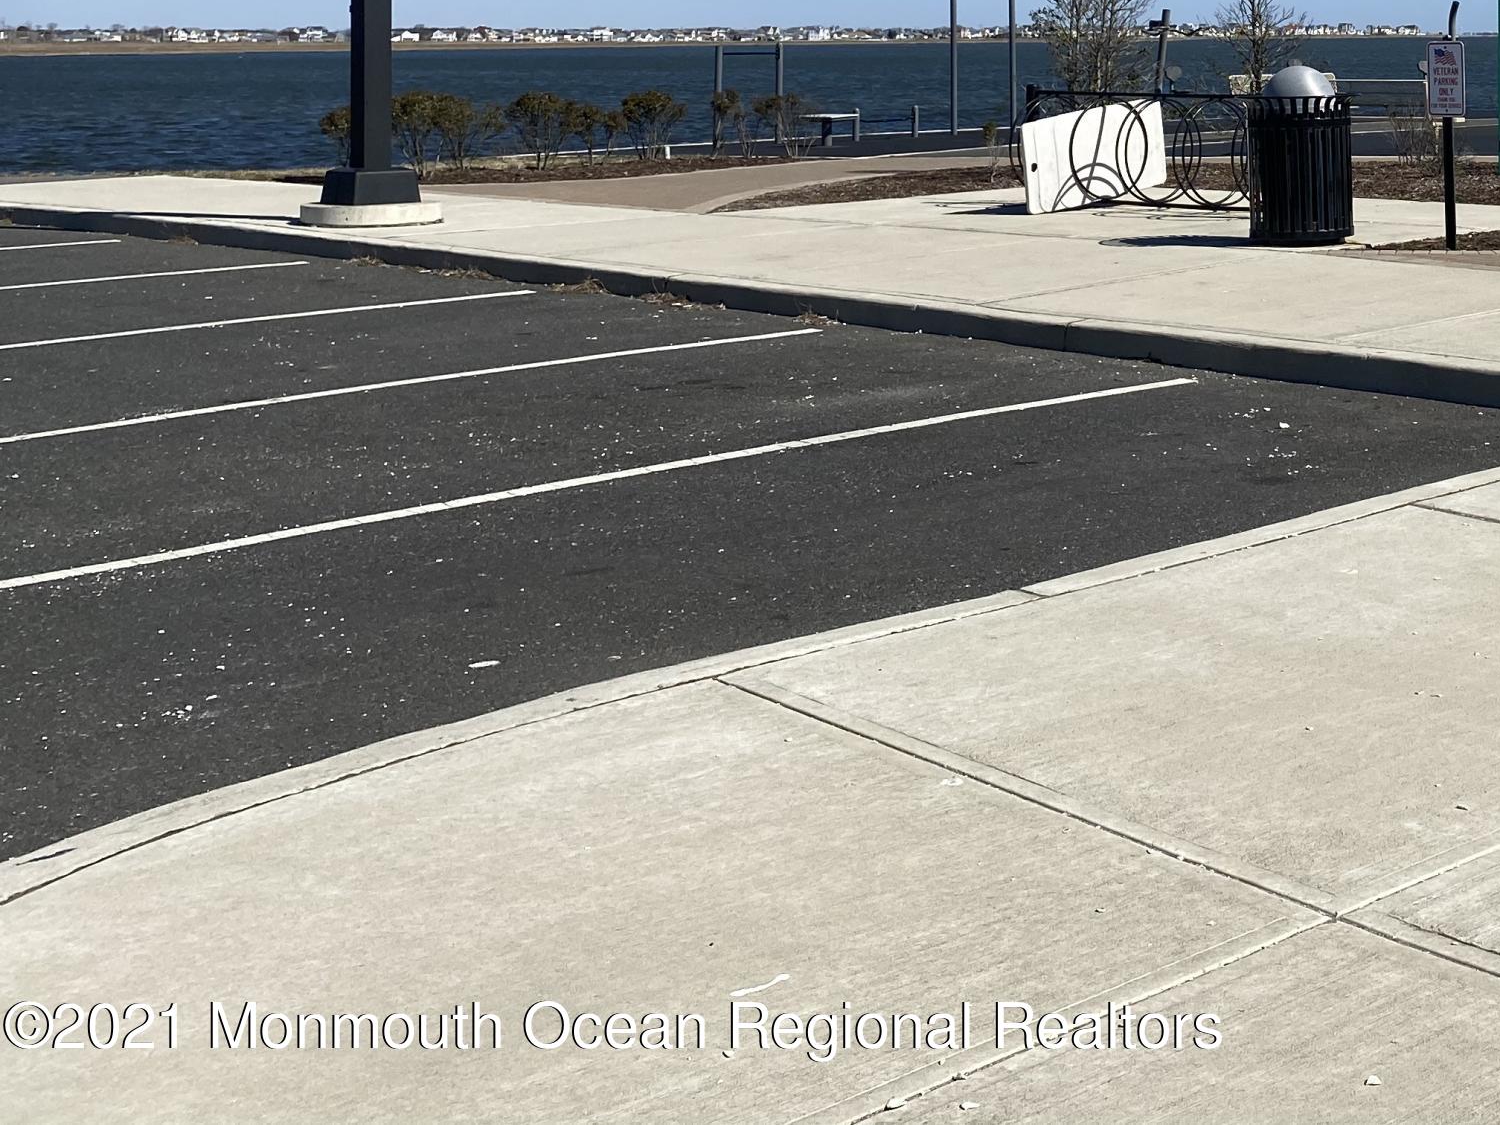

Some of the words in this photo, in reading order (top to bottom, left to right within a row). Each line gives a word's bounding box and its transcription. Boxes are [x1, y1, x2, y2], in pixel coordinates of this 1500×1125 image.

[1433, 67, 1459, 76] VETERAN
[1434, 77, 1459, 86] PARKING
[1439, 87, 1454, 96] ONLY
